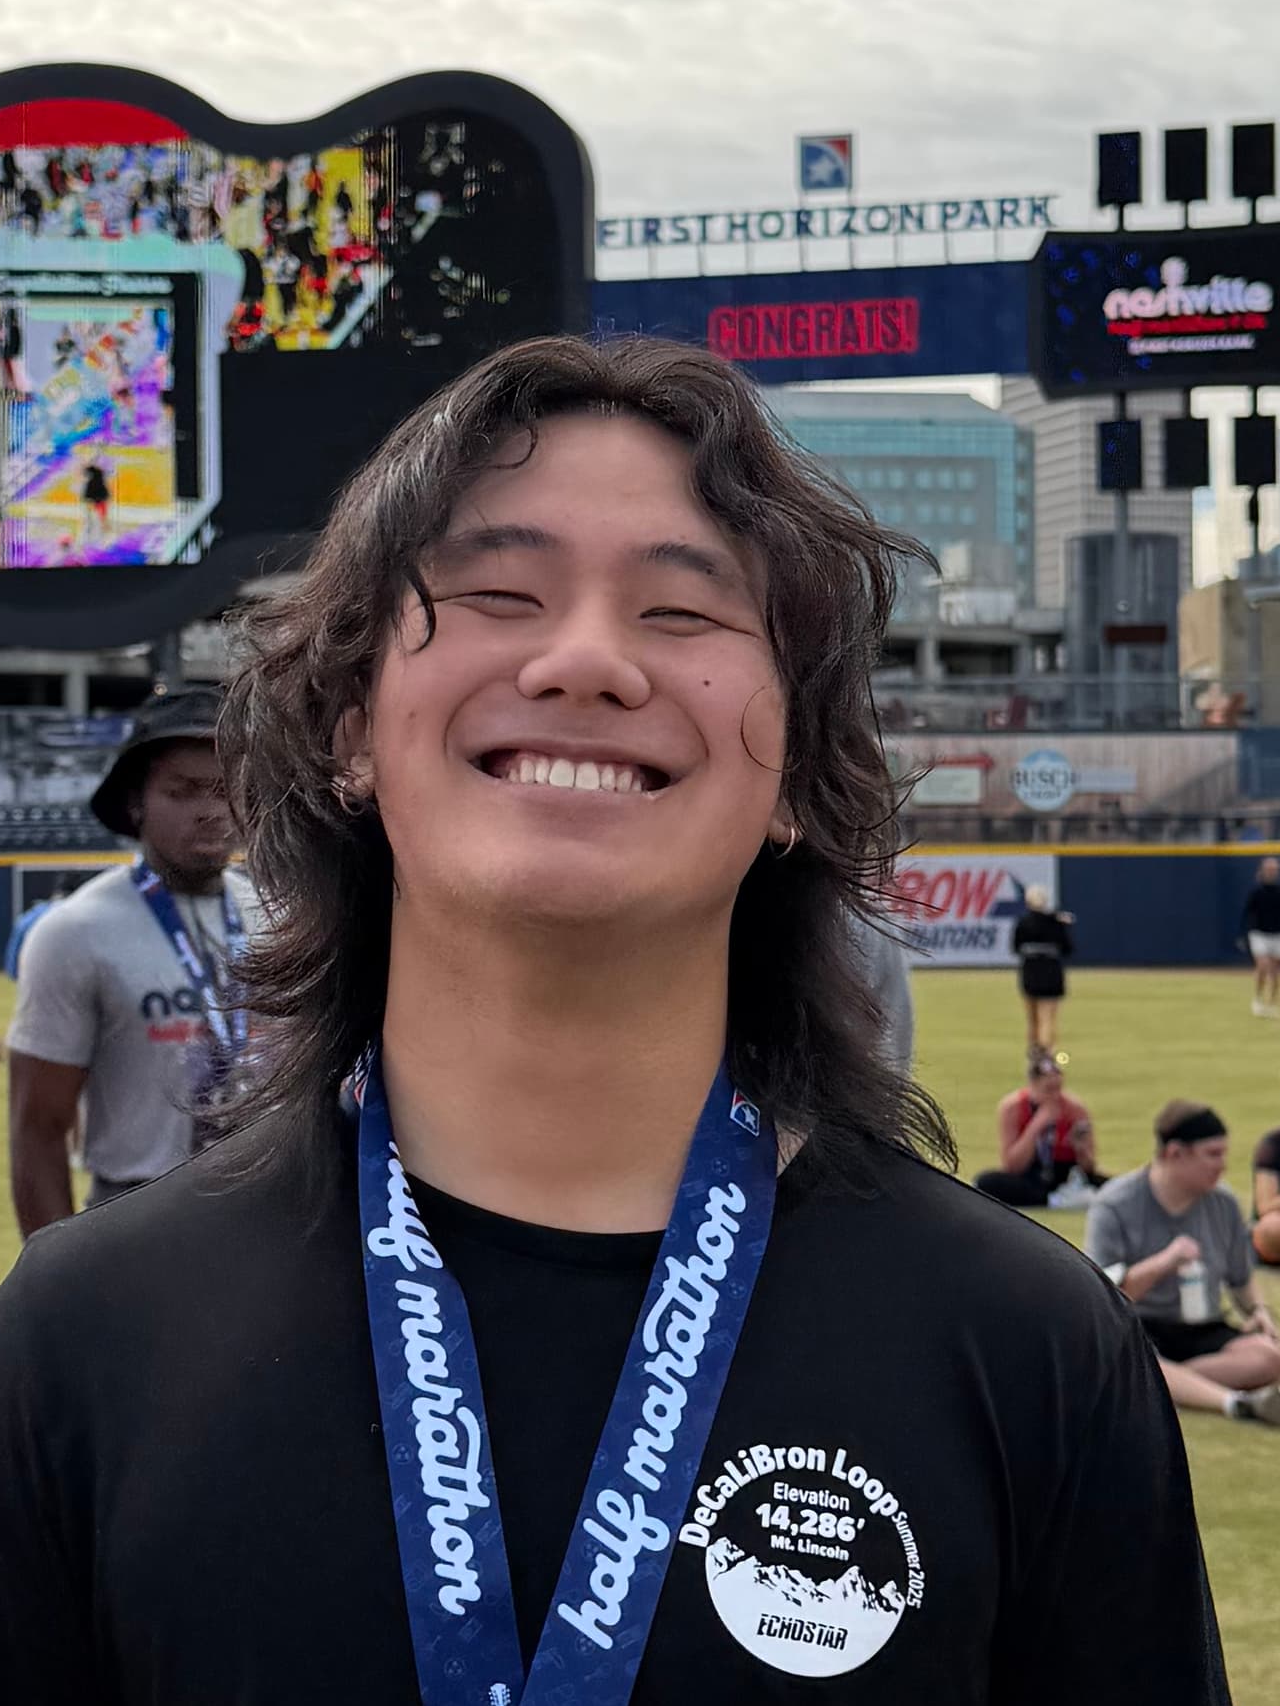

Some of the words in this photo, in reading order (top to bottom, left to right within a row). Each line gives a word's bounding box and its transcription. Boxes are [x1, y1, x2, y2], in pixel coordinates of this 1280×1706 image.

[596, 215, 720, 248] FIRST
[724, 203, 935, 241] HORIZON
[941, 195, 1059, 230] PARK
[714, 299, 914, 359] CONGRATS!
[557, 1489, 670, 1650] half
[623, 1182, 747, 1492] marathon
[395, 1279, 491, 1617] marathon
[678, 1444, 826, 1548] DeCaLiBron
[831, 1448, 900, 1518] Loop
[773, 1481, 850, 1511] Elevation
[770, 1534, 796, 1552] Mt.
[797, 1538, 850, 1562] Lincoln
[891, 1510, 921, 1569] Summer
[906, 1569, 926, 1609] 2025
[756, 1613, 849, 1651] ECHOSTAR
